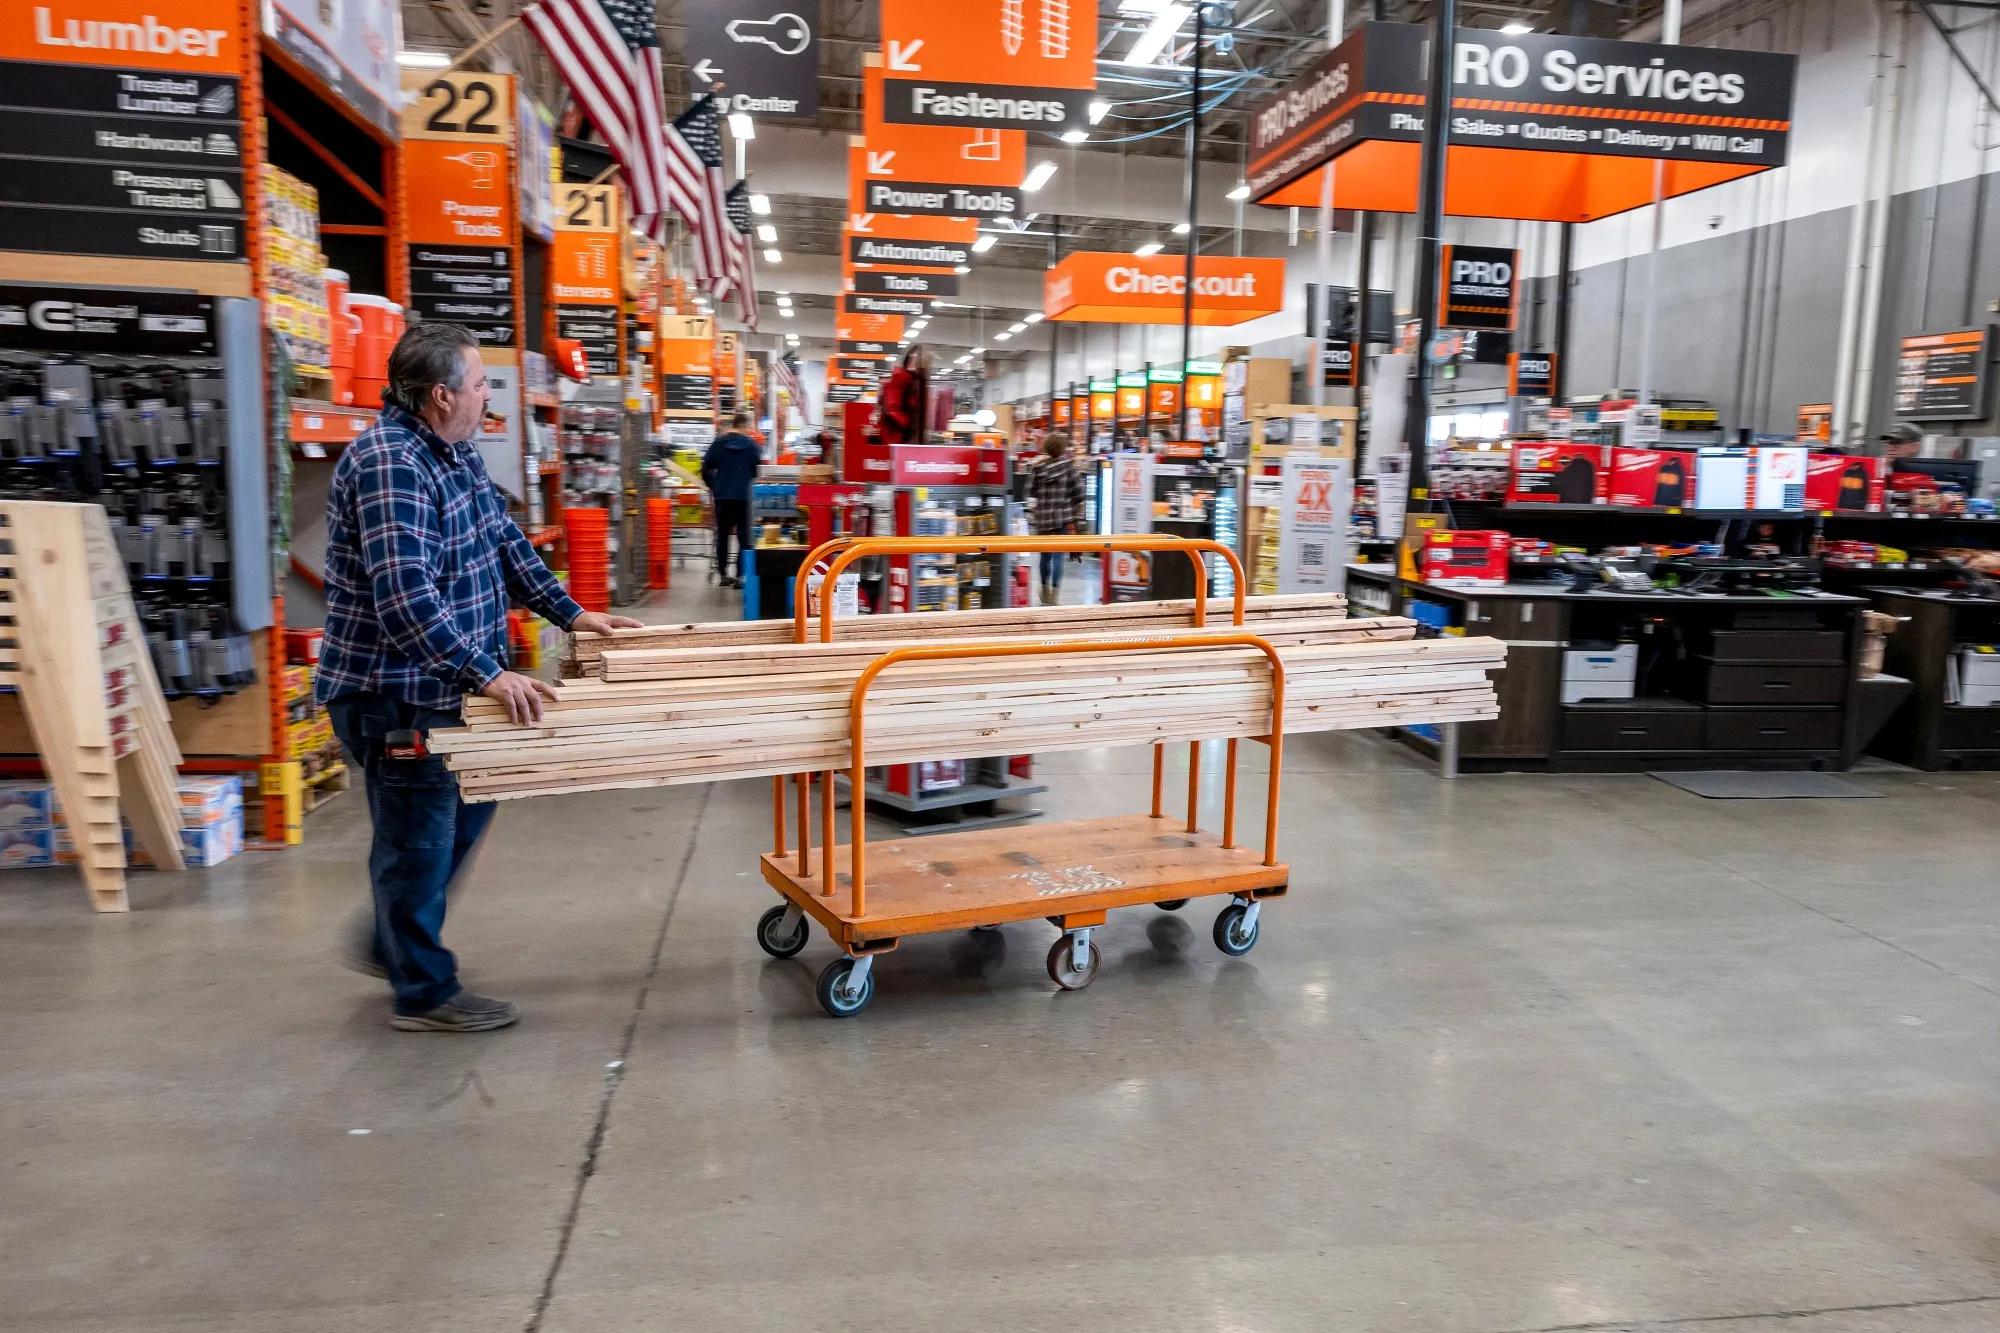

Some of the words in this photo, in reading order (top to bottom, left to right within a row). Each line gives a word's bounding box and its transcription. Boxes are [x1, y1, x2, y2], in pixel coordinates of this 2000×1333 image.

[35, 7, 228, 57] Lumber
[1420, 41, 1529, 88] RO
[1540, 50, 1745, 103] Services
[117, 74, 198, 95] Treated
[117, 93, 198, 114] Lumber
[425, 79, 498, 134] 22
[732, 93, 799, 113] Center
[911, 87, 1066, 123] Fasteners
[95, 130, 203, 153] Hardwood
[1451, 117, 1505, 136] Sales
[1520, 122, 1588, 142] Quotes
[1602, 128, 1677, 151] Delivery
[1691, 134, 1727, 151] Will
[1727, 137, 1764, 154] Call
[112, 169, 206, 191] Pressure
[126, 189, 207, 210] Treated
[441, 200, 502, 217] Power
[567, 189, 610, 227] 21
[872, 186, 948, 210] Power
[950, 189, 1016, 213] Tools
[138, 227, 201, 246] Studs
[451, 220, 503, 237] Tools
[858, 241, 967, 263] Automotive
[882, 275, 929, 291] Tools
[1105, 266, 1256, 297] Checkout
[1452, 260, 1511, 285] PRO
[1519, 360, 1551, 373] PRO
[1125, 395, 1141, 409] 3
[1158, 390, 1174, 406] 2
[1198, 385, 1213, 401] 1
[1097, 399, 1113, 412] 4
[1296, 482, 1333, 511] 4X
